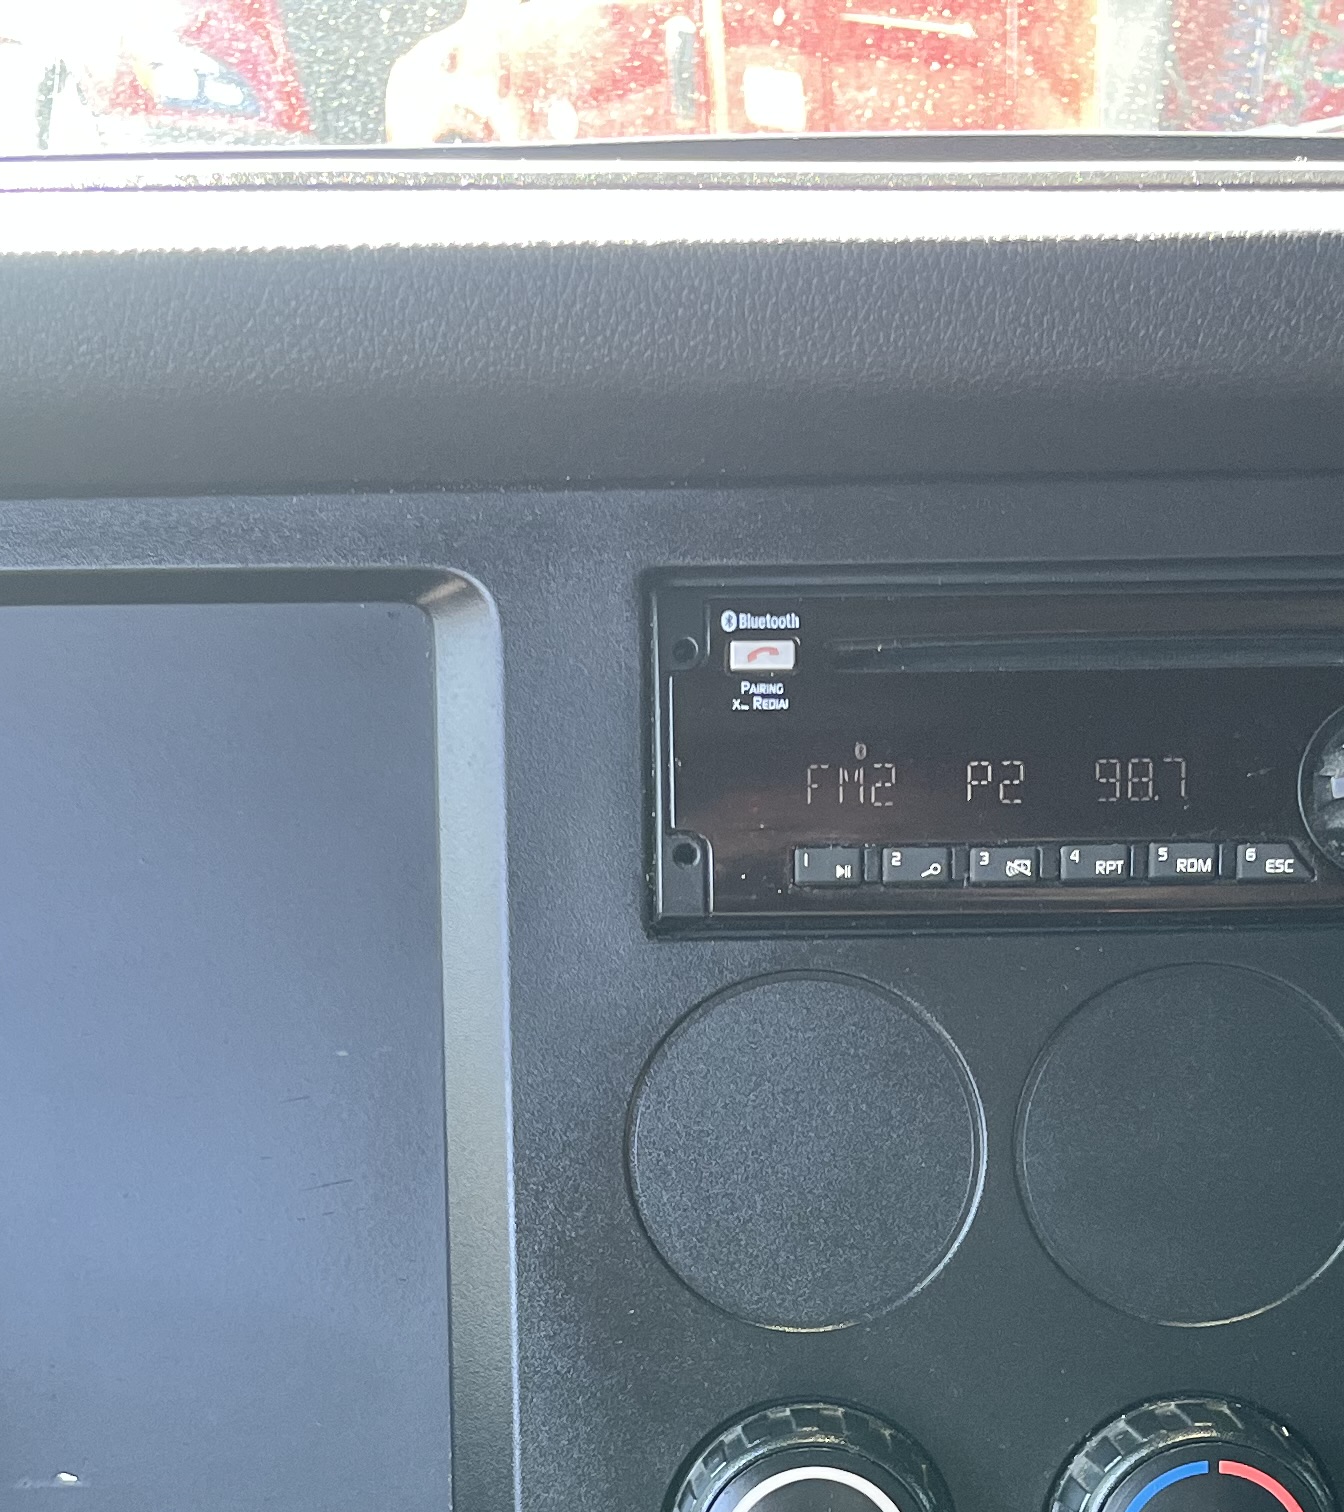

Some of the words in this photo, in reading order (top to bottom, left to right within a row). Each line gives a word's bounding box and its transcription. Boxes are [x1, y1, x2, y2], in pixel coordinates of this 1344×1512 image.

[738, 612, 800, 629] Bluetooth
[807, 763, 896, 807] FM2
[967, 760, 1025, 804] P2
[891, 851, 902, 867] 2
[979, 851, 990, 866] 3
[1069, 849, 1080, 864] 4
[1157, 847, 1169, 862] 5
[1245, 847, 1257, 862] 6
[1095, 859, 1125, 875] RPT
[1175, 858, 1212, 873] RDM
[1265, 858, 1295, 873] ESC
